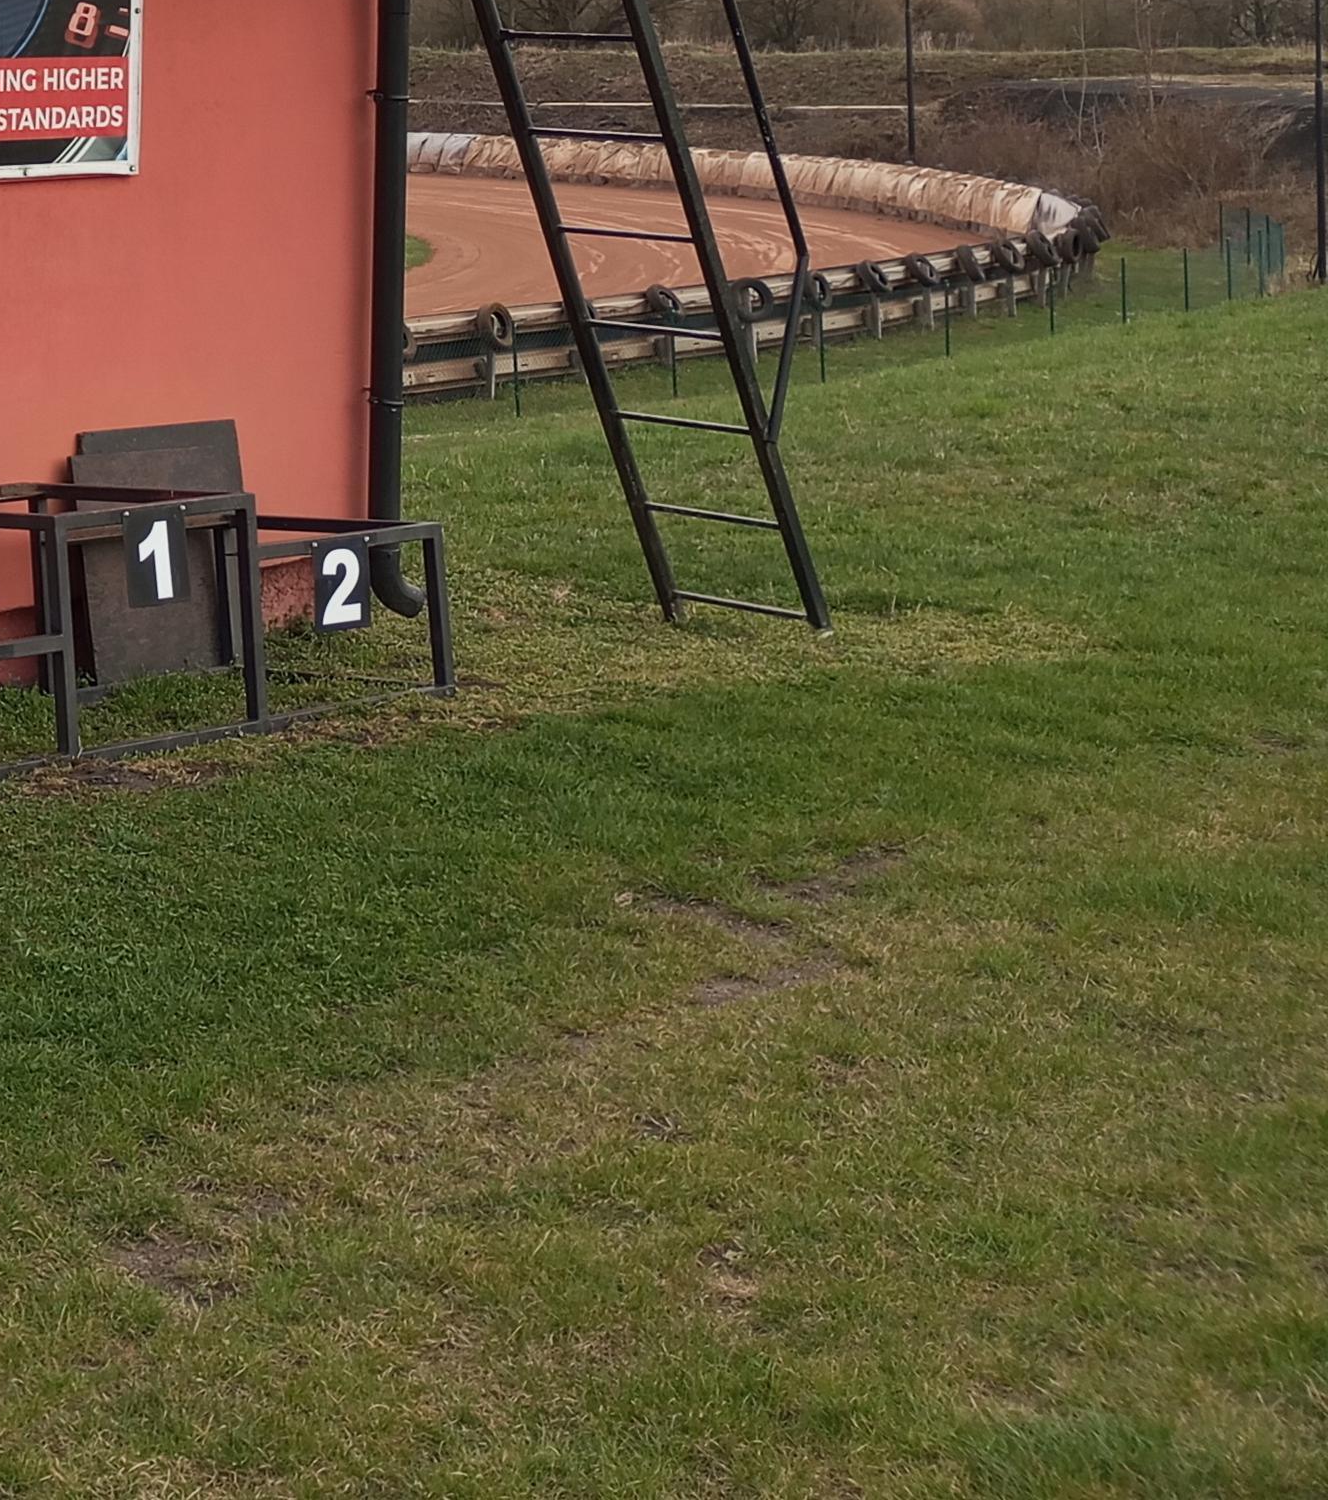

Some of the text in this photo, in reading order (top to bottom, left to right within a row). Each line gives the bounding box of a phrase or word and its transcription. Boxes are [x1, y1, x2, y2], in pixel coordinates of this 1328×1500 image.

[68, 1, 98, 37] 8
[43, 67, 125, 93] HIGHER
[138, 519, 174, 600] 1
[322, 547, 363, 626] 2
